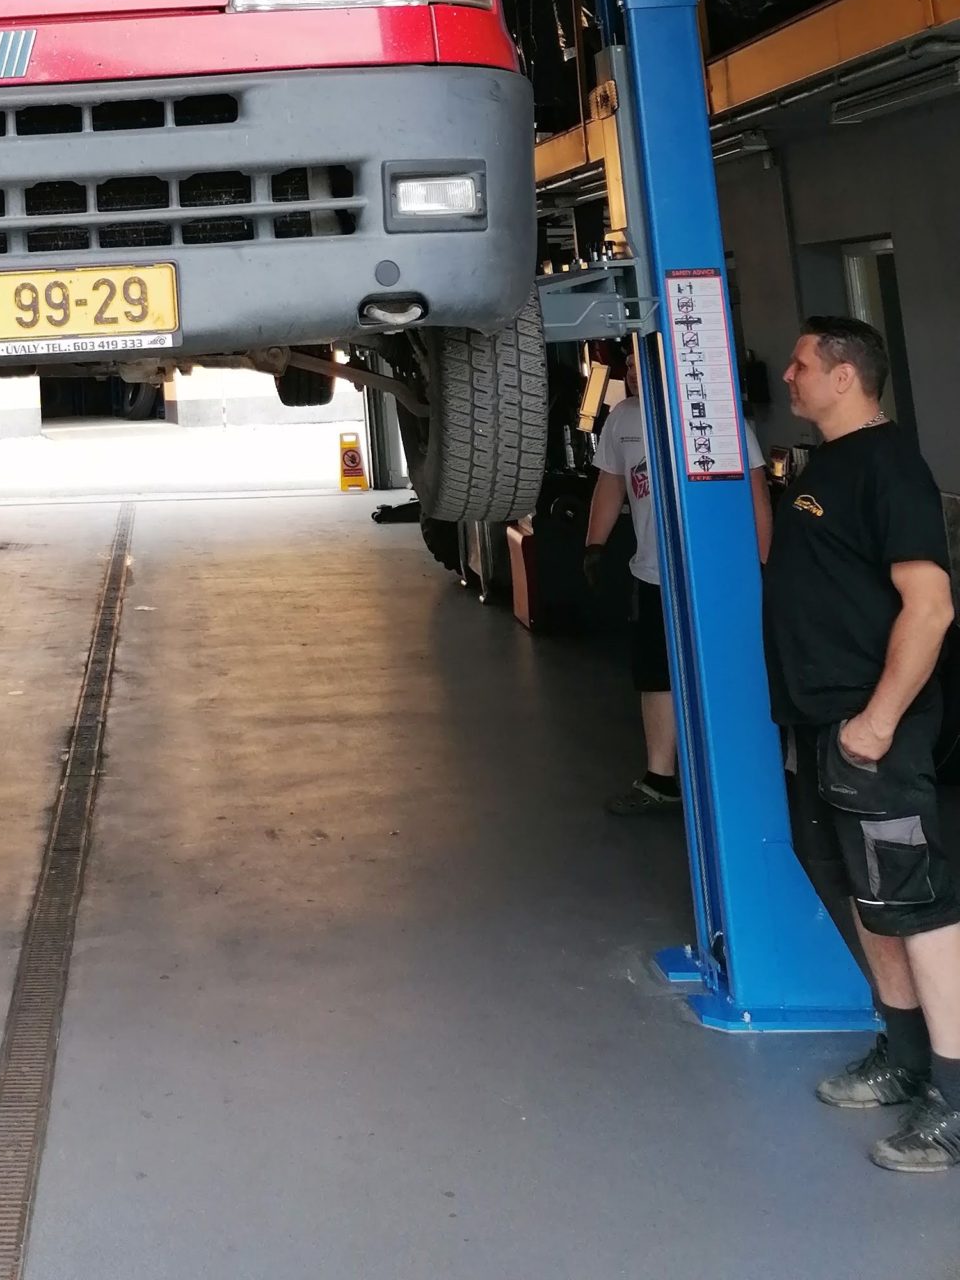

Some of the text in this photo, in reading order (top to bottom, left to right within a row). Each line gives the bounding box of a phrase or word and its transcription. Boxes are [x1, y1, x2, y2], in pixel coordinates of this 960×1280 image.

[13, 275, 149, 328] 99-29
[45, 342, 71, 353] TEL.:
[73, 341, 96, 351] 603
[98, 340, 118, 350] 419
[121, 338, 143, 349] 333
